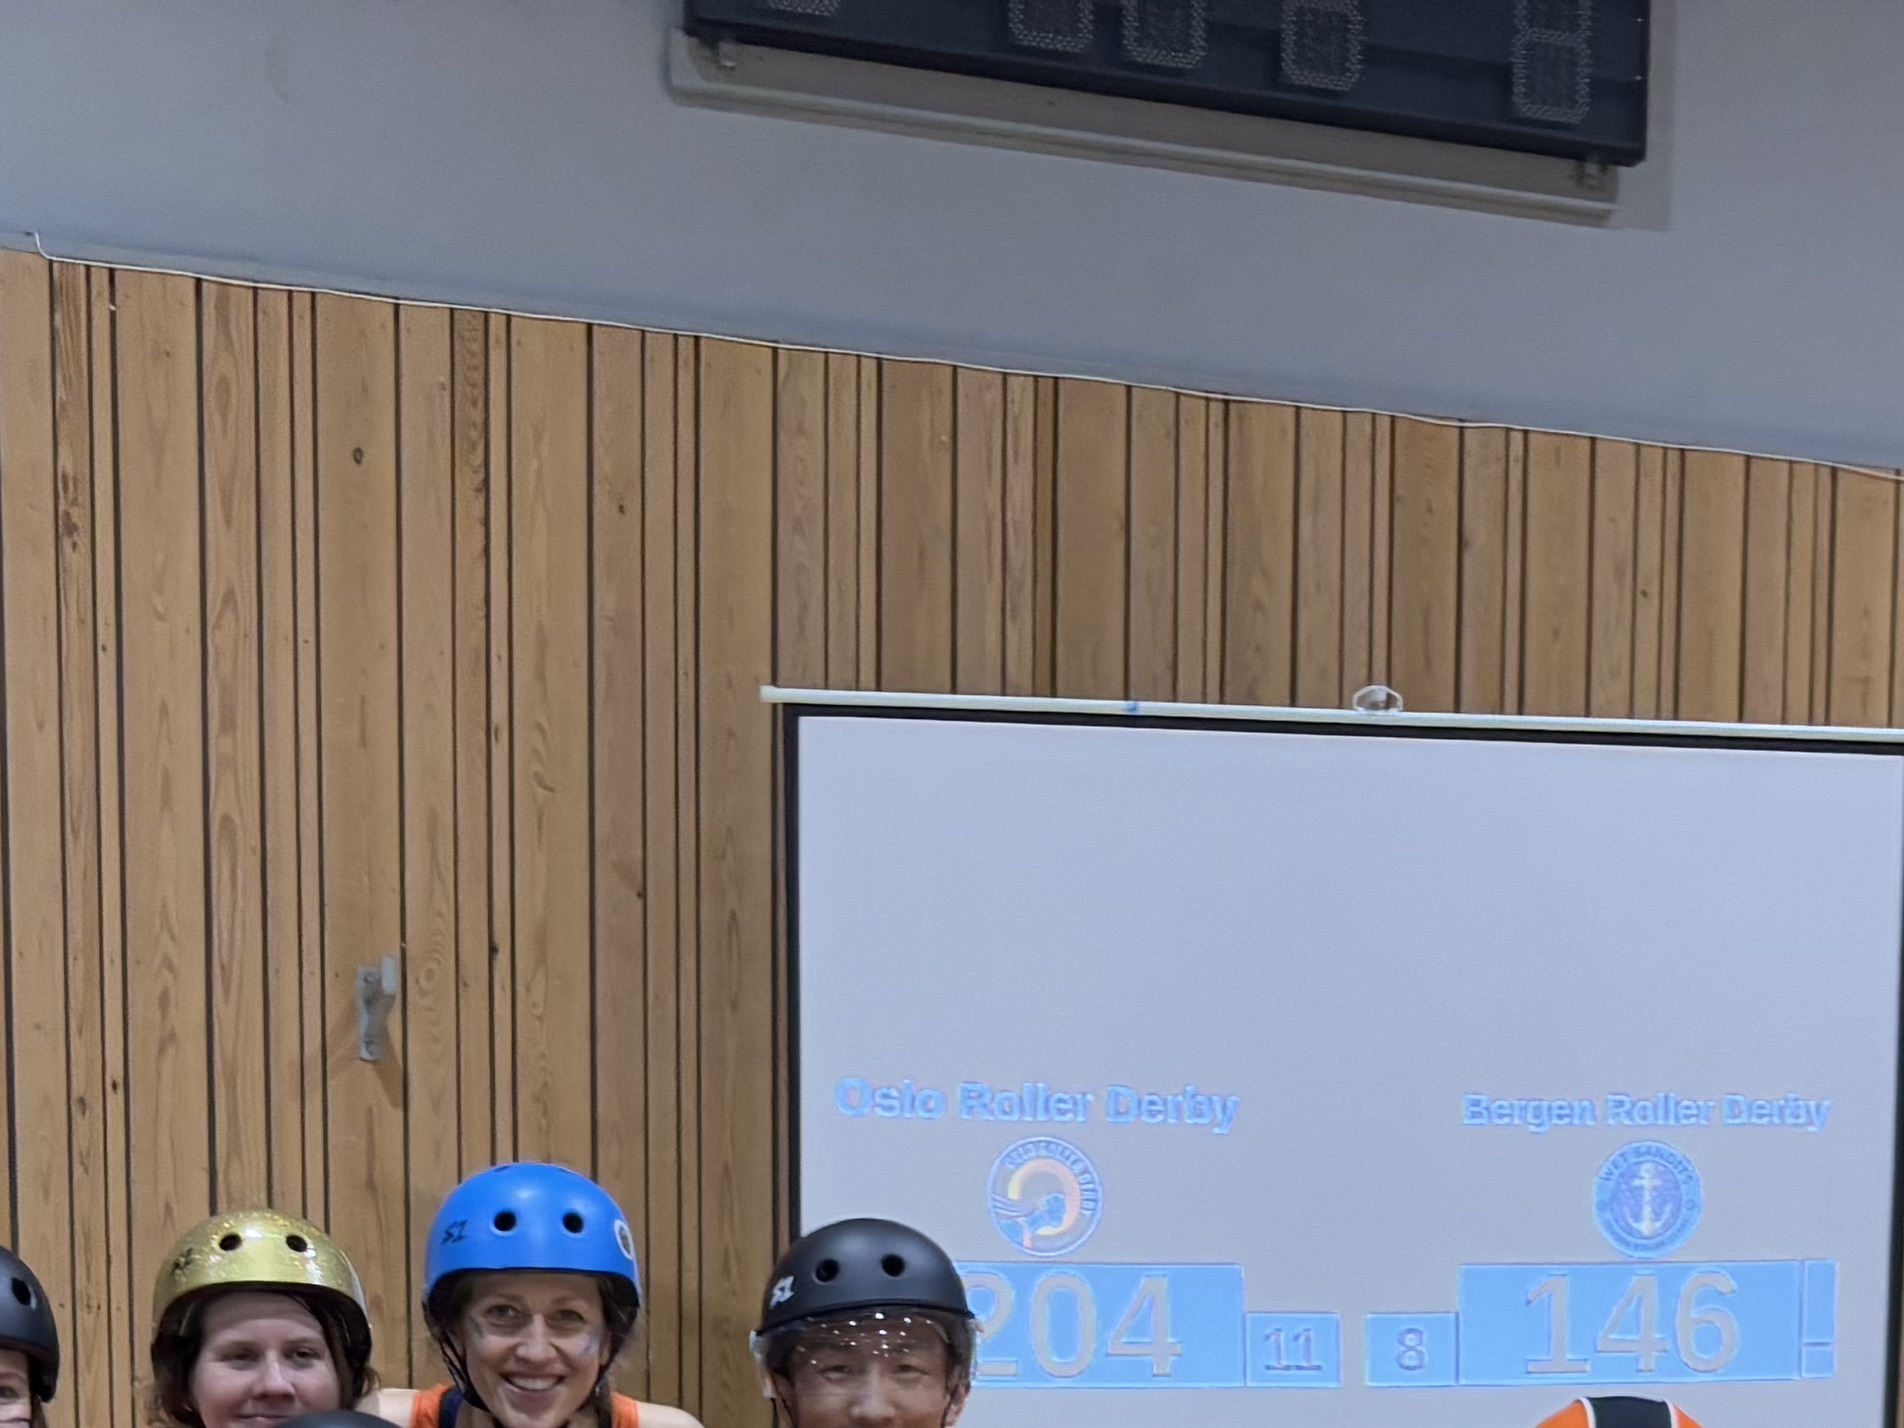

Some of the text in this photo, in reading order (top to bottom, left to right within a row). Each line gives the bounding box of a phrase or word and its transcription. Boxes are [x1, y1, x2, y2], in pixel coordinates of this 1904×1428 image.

[834, 1078, 1239, 1135] Oslo Roller Derby
[1462, 1092, 1832, 1134] Bergen Roller Derby
[968, 1270, 1183, 1381] 204
[1525, 1269, 1739, 1375] 146
[1264, 1329, 1322, 1373] 11
[1397, 1327, 1426, 1371] 8
